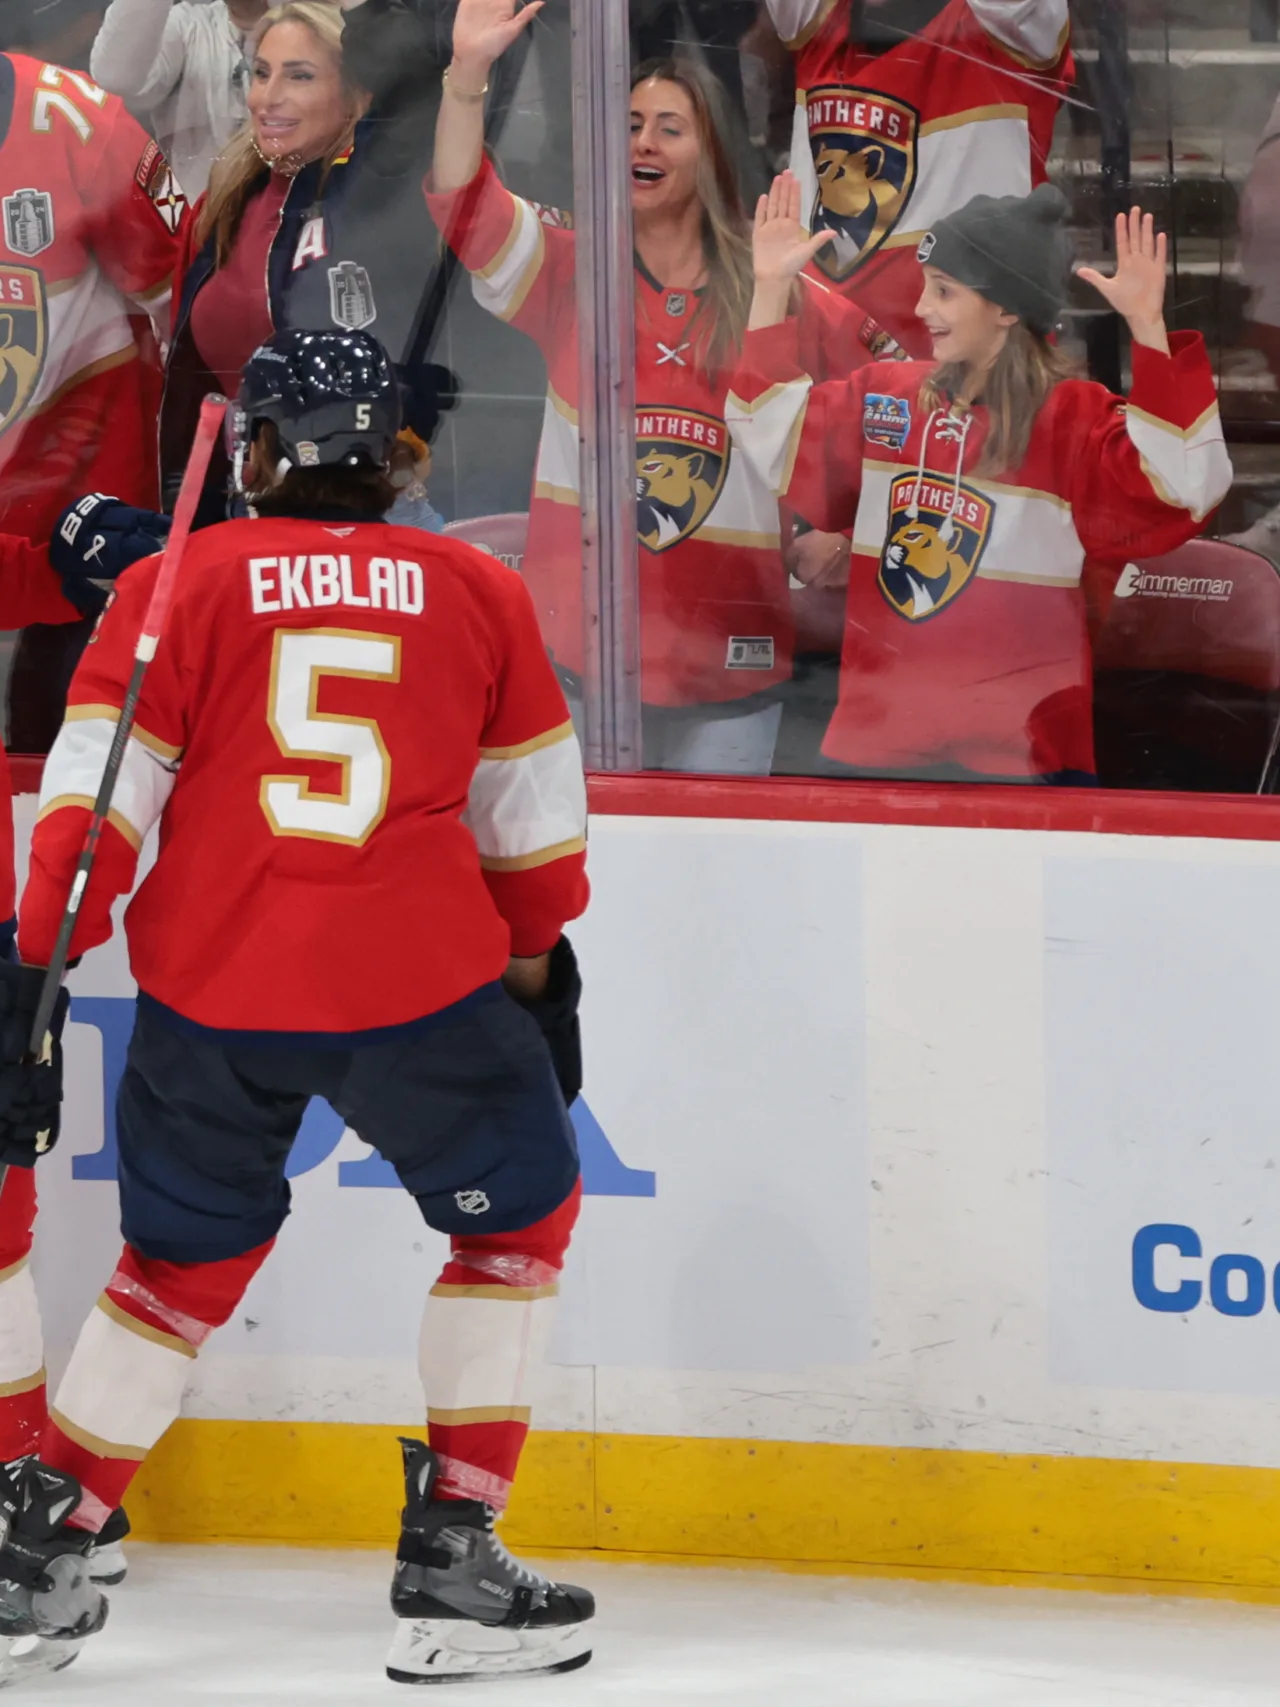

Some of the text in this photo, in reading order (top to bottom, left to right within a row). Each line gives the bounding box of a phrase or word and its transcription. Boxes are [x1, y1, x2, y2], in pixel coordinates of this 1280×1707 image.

[292, 217, 328, 271] A
[355, 404, 371, 430] 5
[897, 484, 979, 522] PATHERS
[249, 555, 424, 616] EKBLAD
[259, 628, 401, 847] 5
[1132, 1223, 1280, 1317] Co
